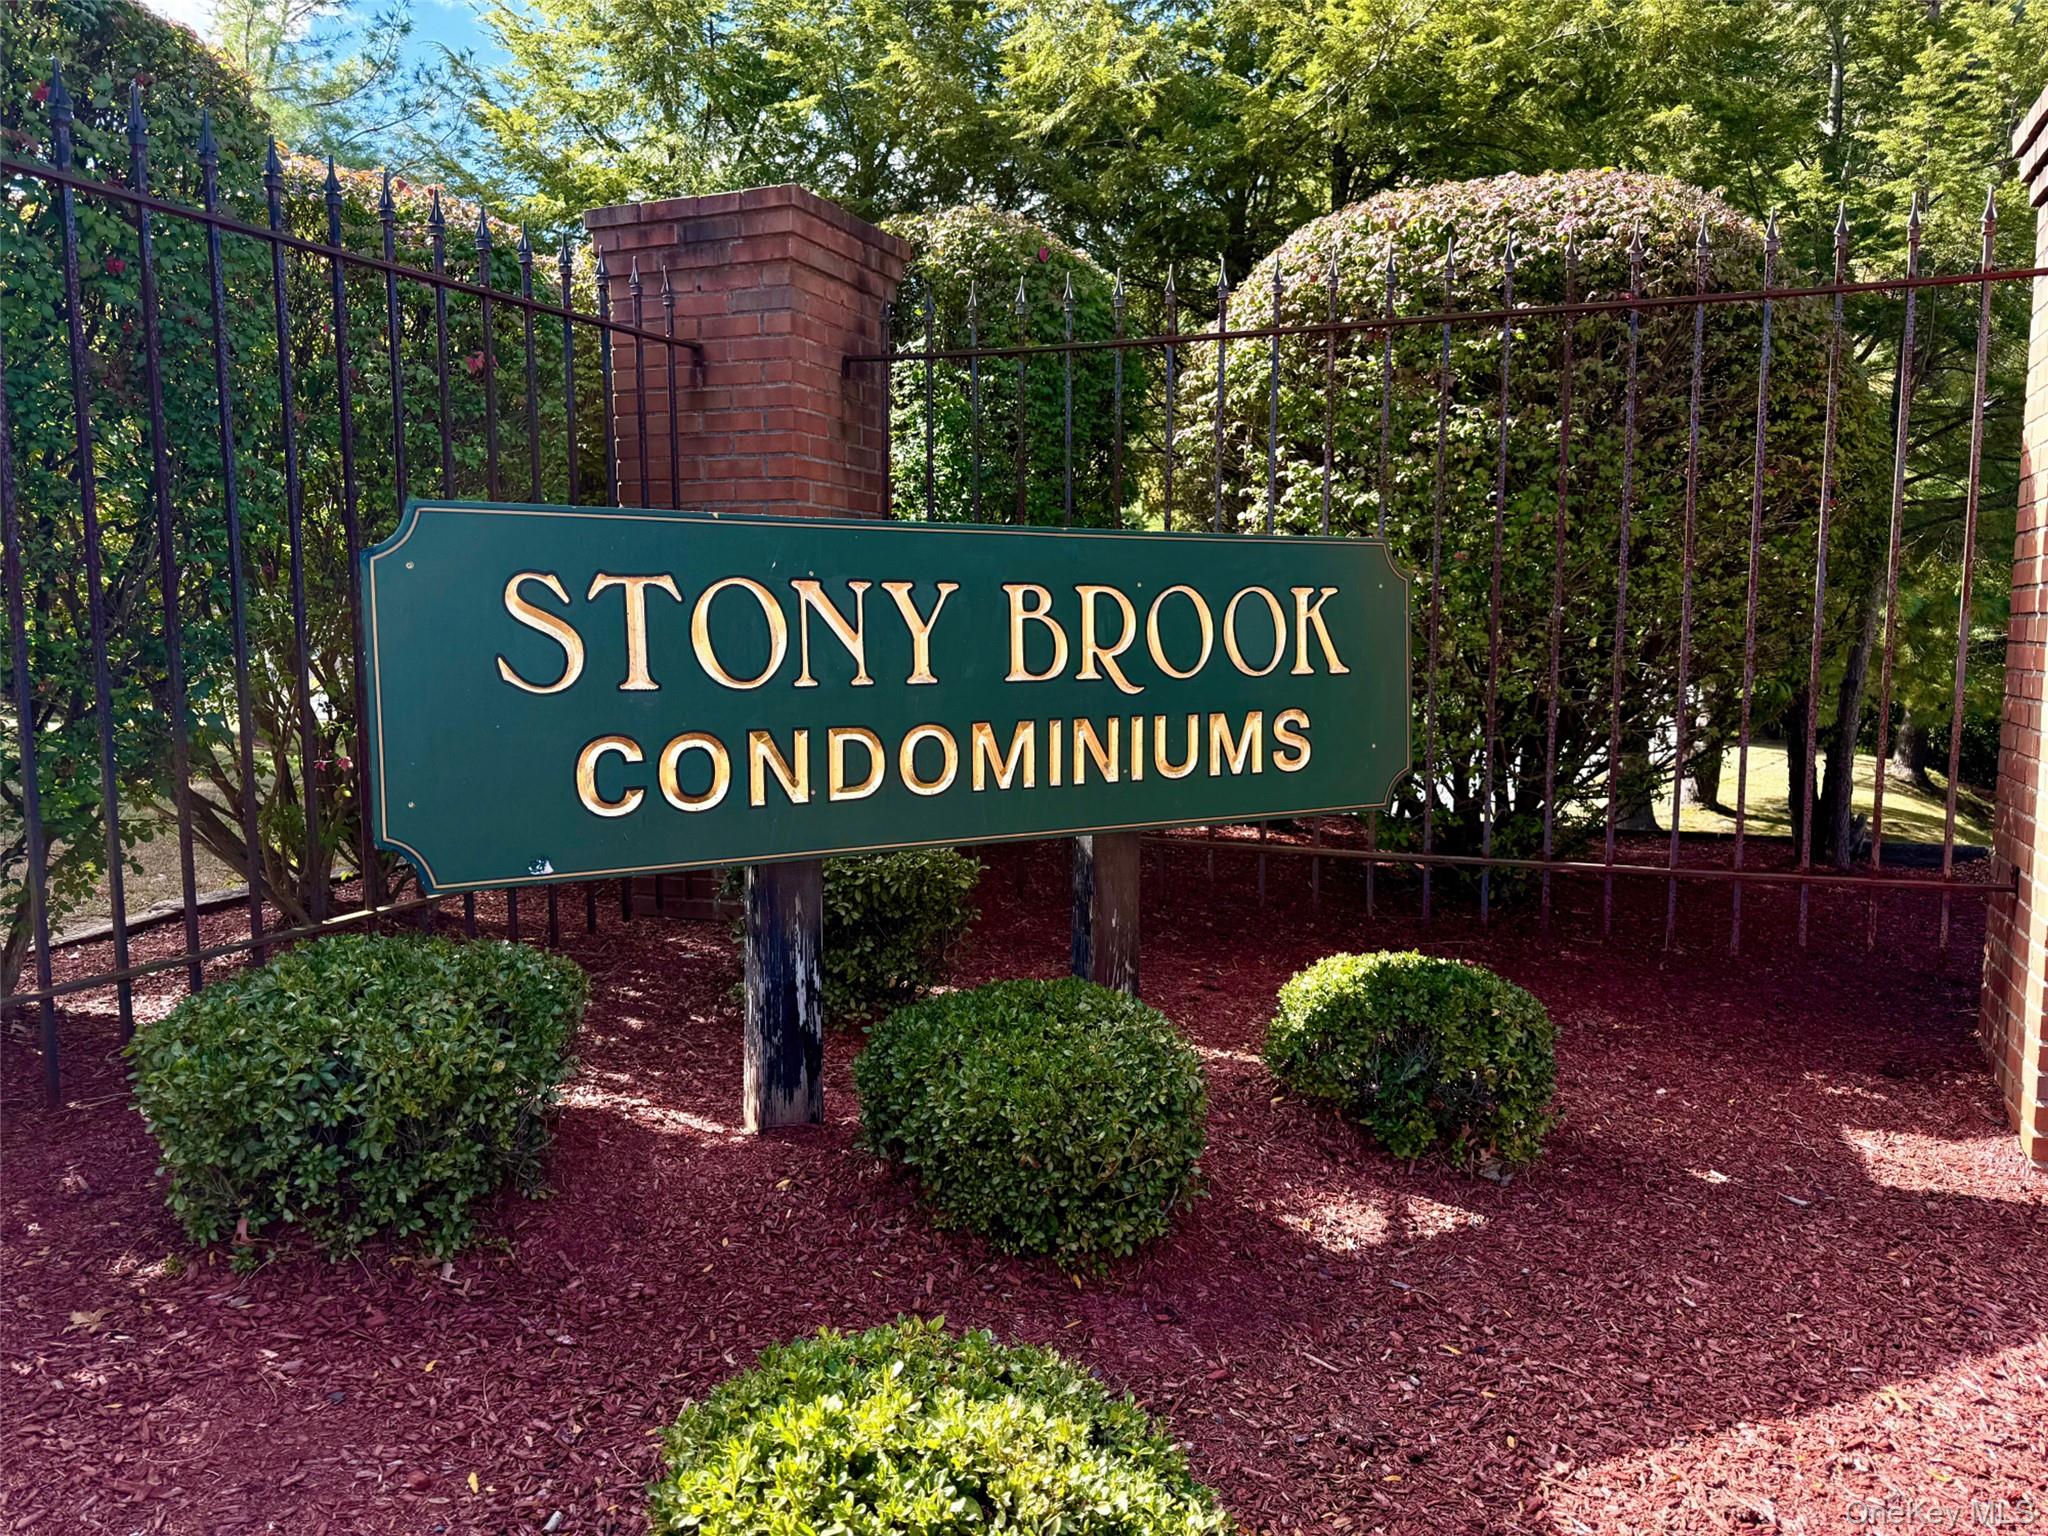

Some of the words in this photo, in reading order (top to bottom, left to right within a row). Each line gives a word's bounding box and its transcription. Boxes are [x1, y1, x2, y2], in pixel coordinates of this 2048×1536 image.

[496, 570, 959, 694] STONY
[1002, 583, 1349, 694] BROOK
[576, 707, 1312, 818] CONDOMINIUMS
